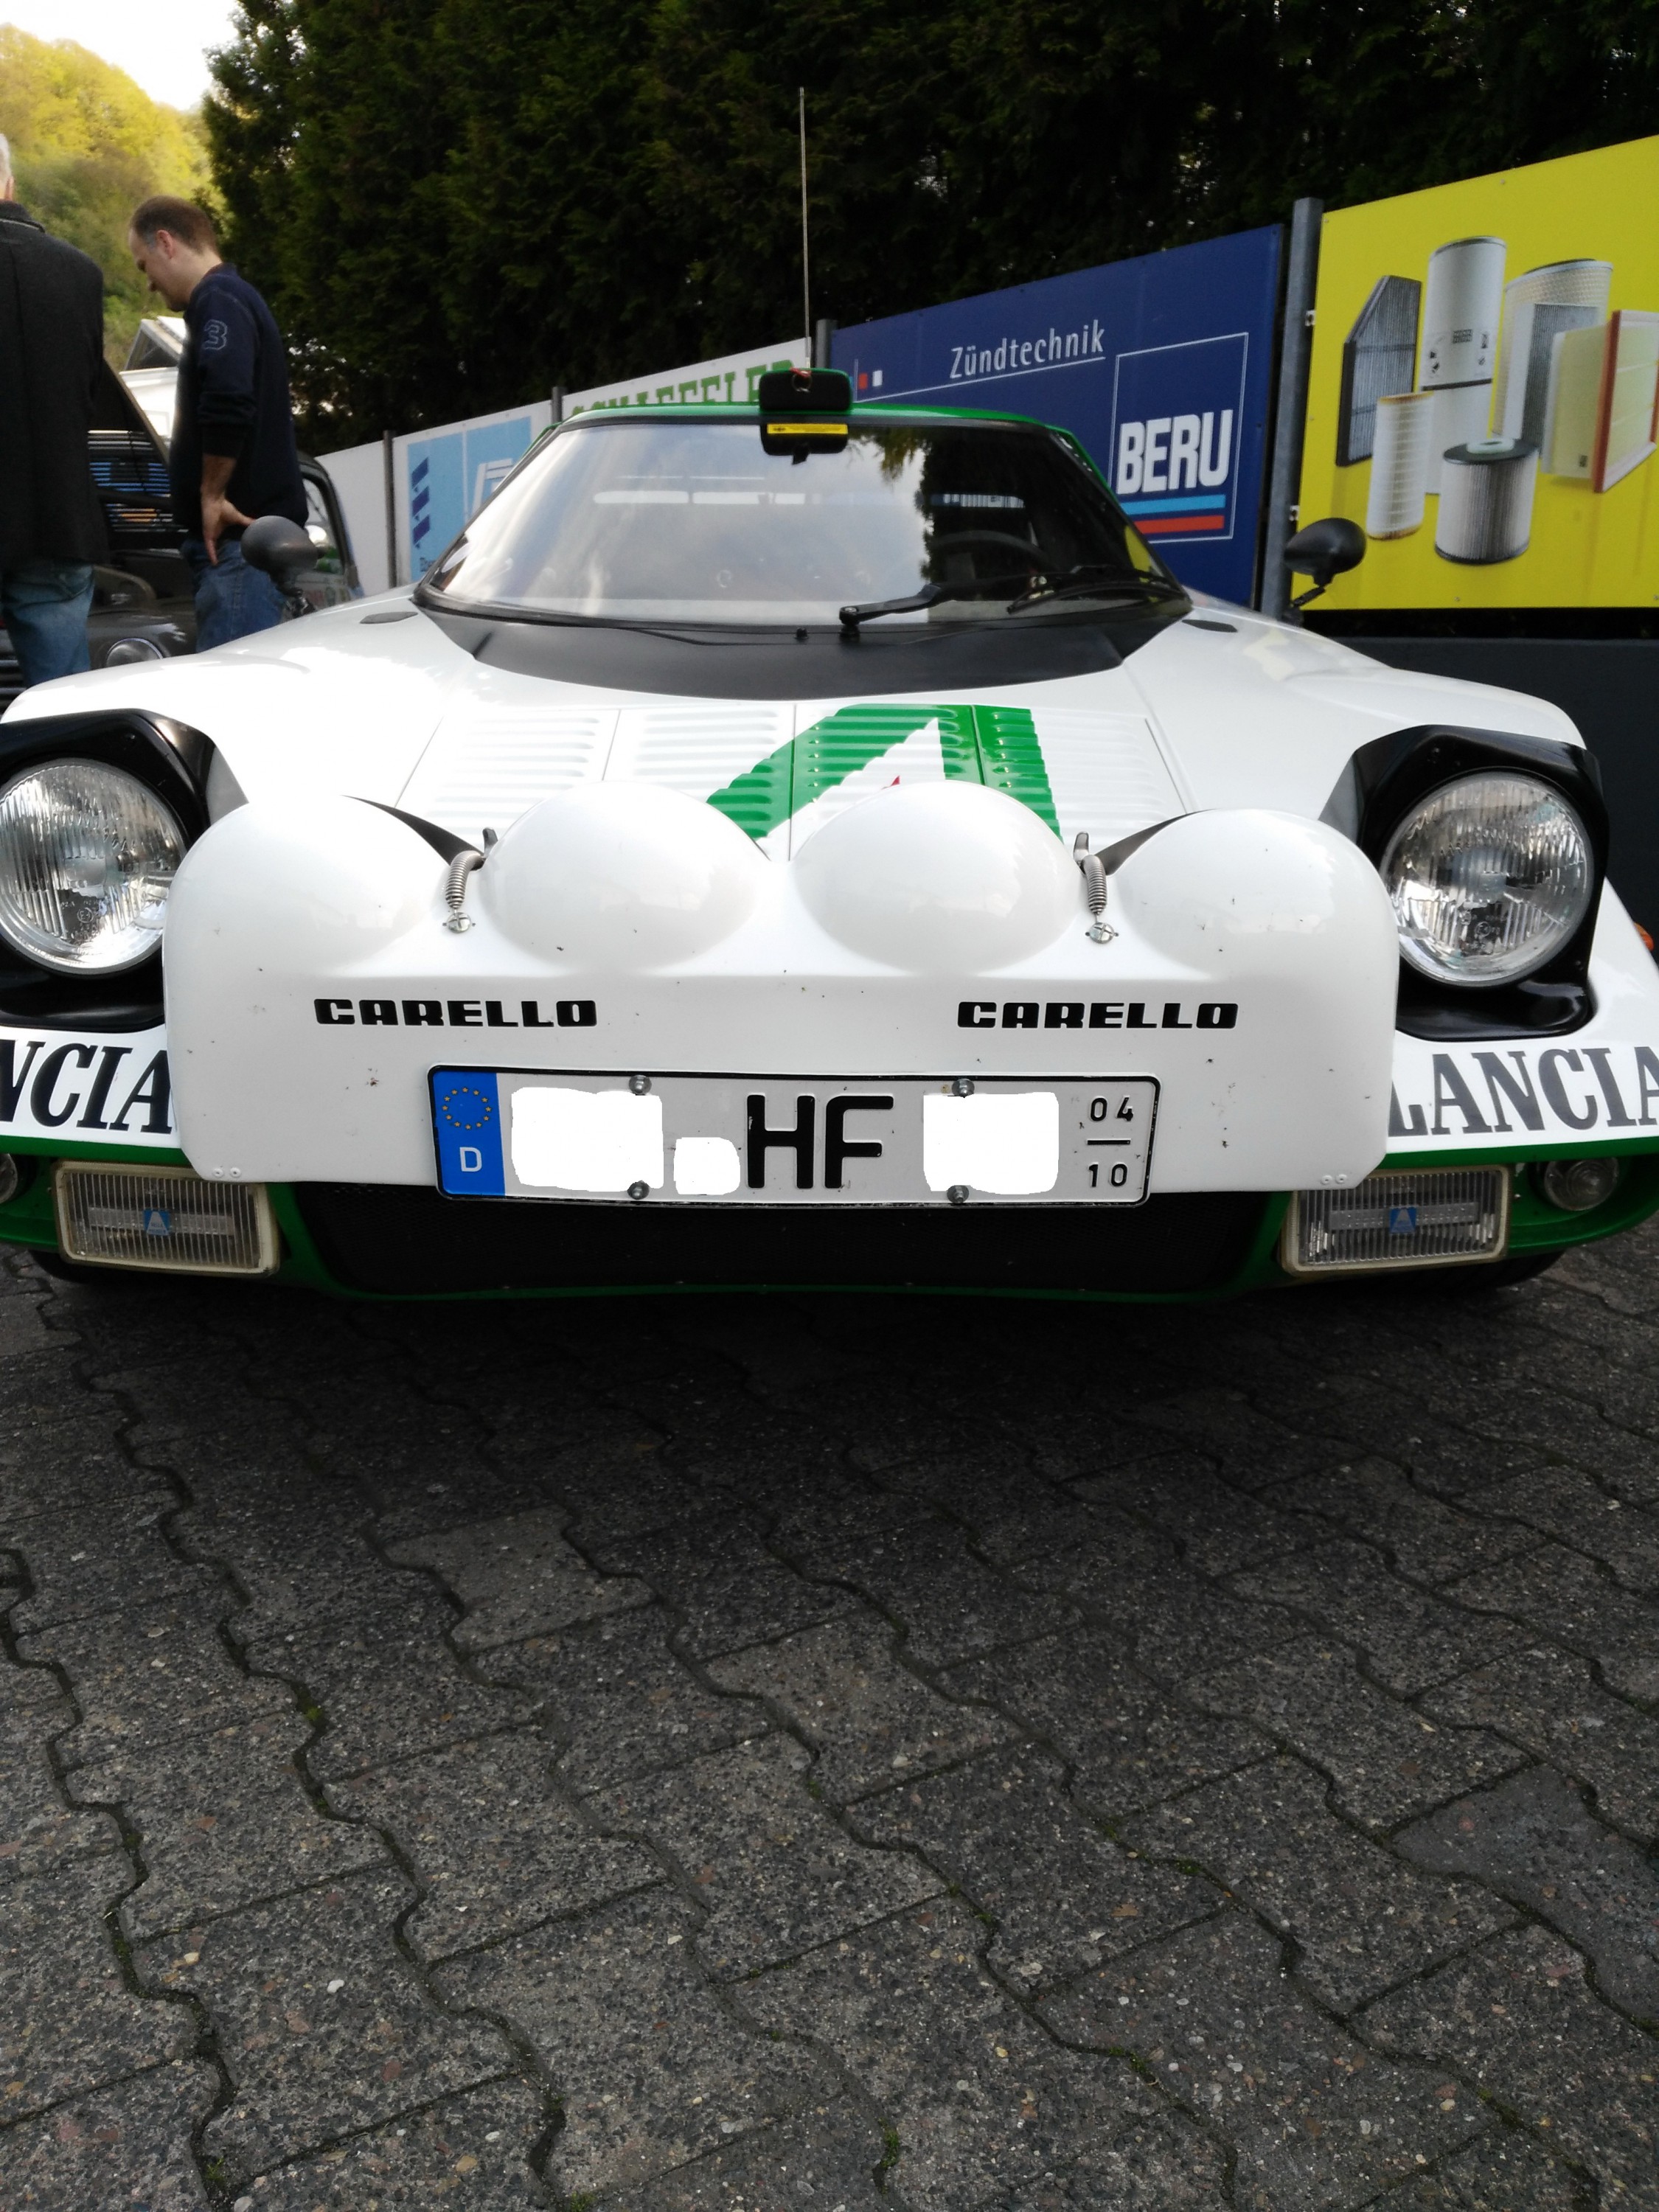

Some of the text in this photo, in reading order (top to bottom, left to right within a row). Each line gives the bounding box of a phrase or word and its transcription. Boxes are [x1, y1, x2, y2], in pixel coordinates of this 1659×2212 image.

[201, 319, 227, 350] 3
[950, 319, 1105, 379] Zündtechnik
[1116, 409, 1233, 495] BERU
[314, 999, 597, 1027] CARELLO
[958, 1002, 1238, 1029] CARELLO
[1091, 1097, 1133, 1121] 04
[459, 1094, 894, 1189] D HF
[1088, 1164, 1127, 1187] 10
